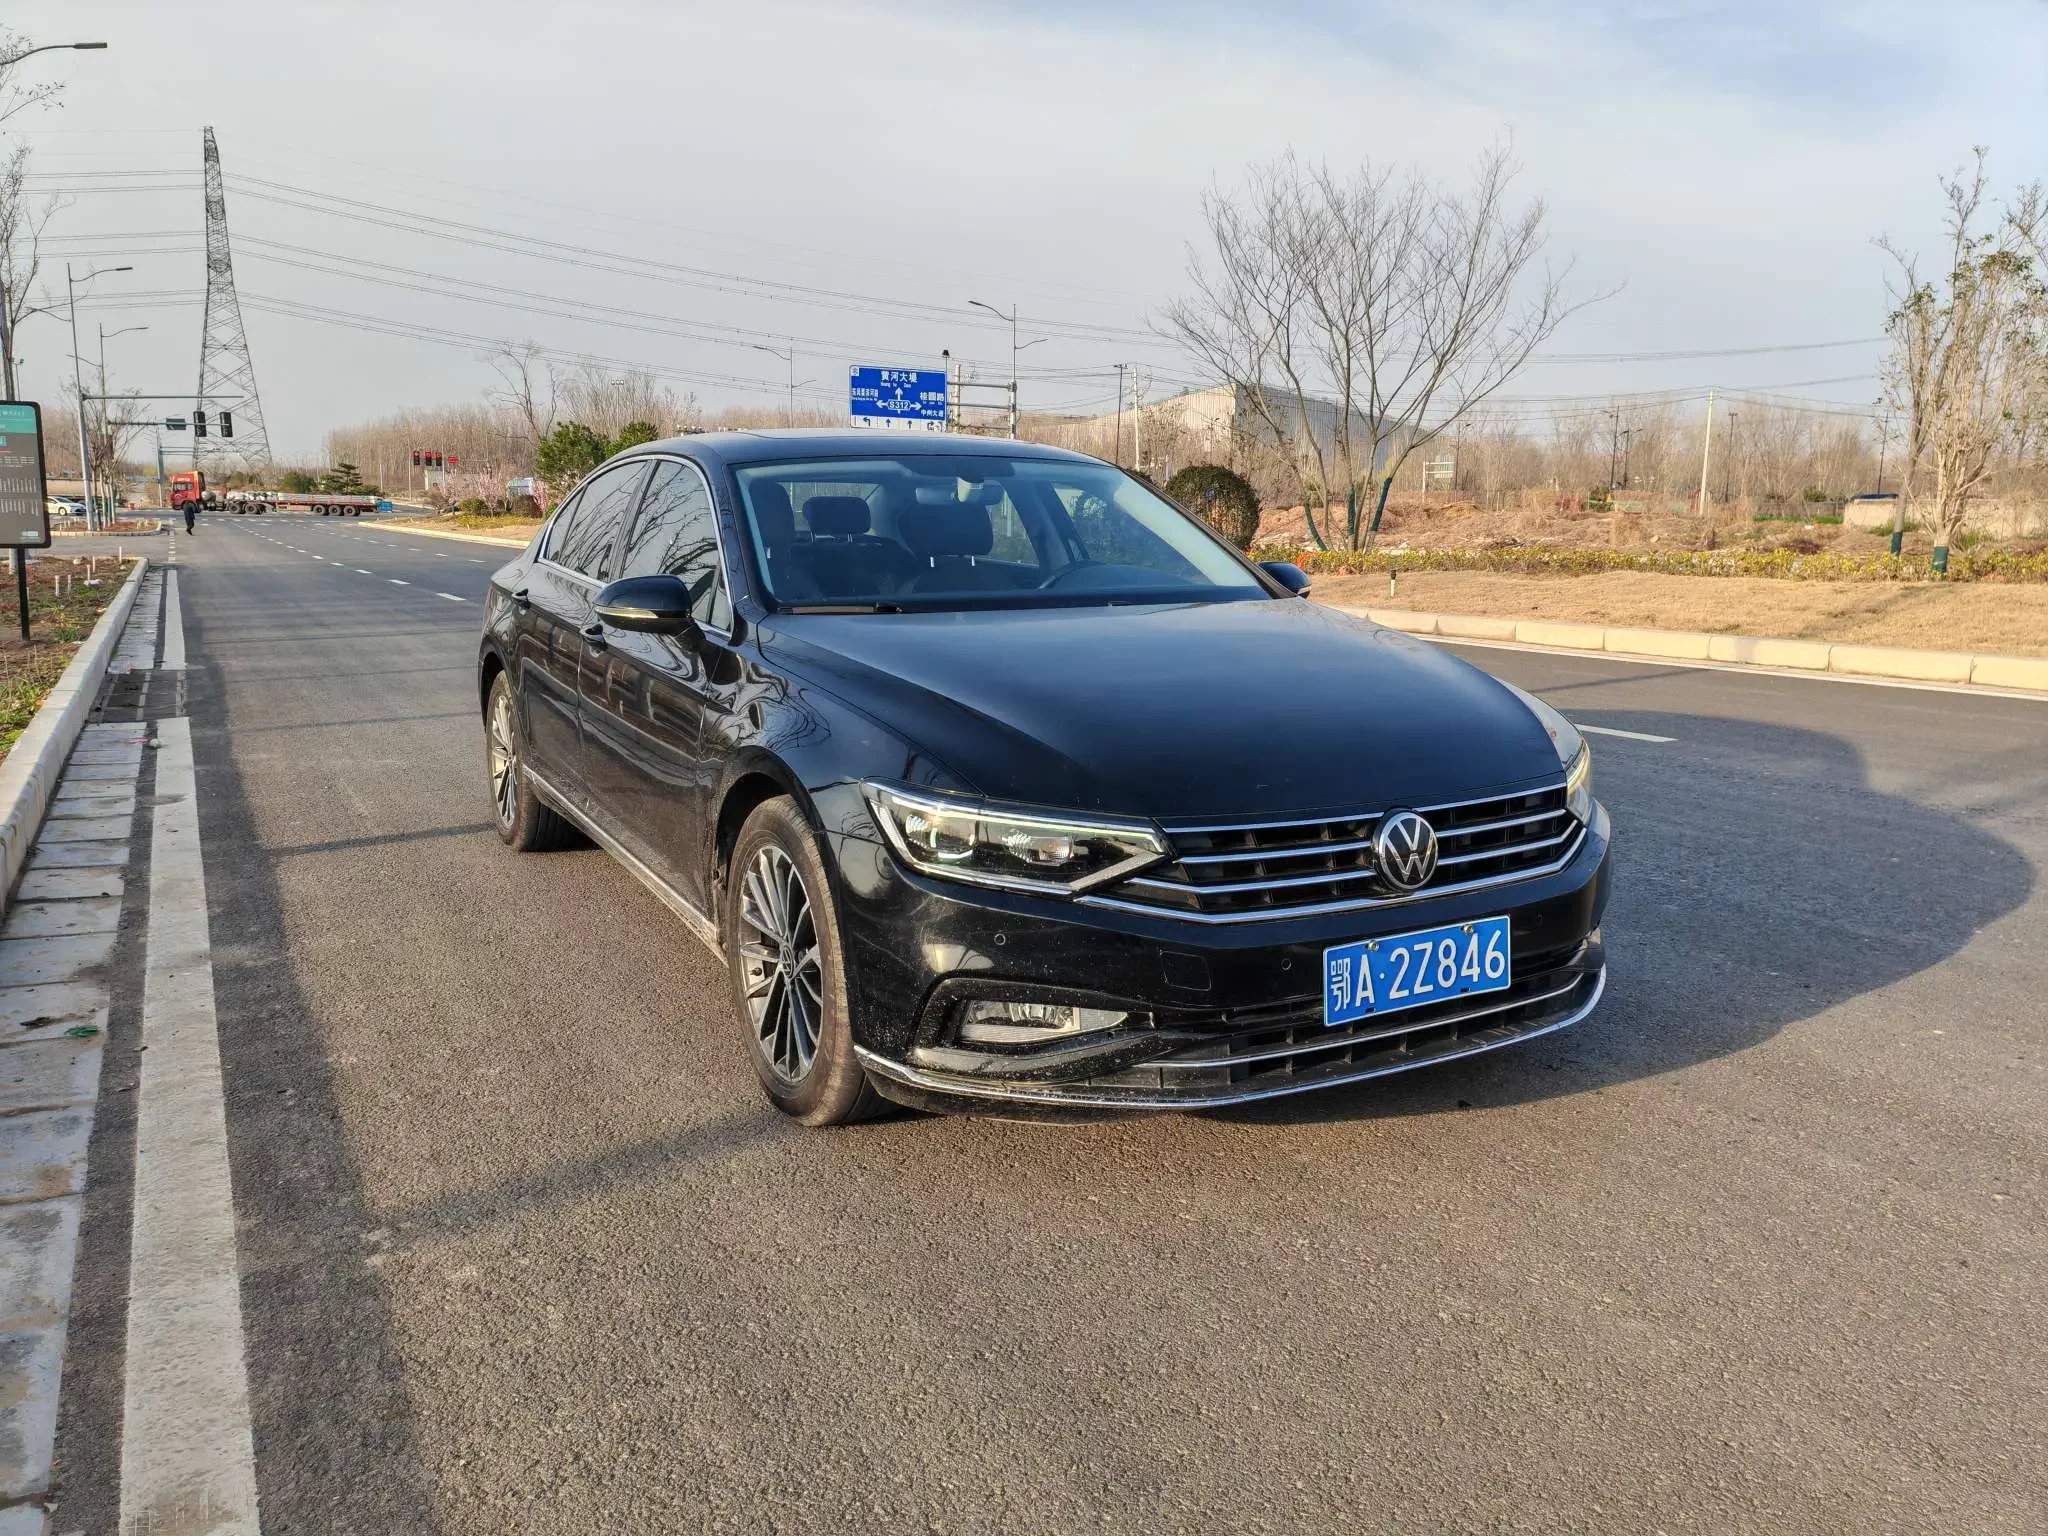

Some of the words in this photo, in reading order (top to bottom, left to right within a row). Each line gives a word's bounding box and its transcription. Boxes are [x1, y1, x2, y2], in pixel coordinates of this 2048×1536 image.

[881, 371, 917, 383] 黄河大堤
[889, 401, 909, 410] S312
[921, 409, 943, 417] 中州大道
